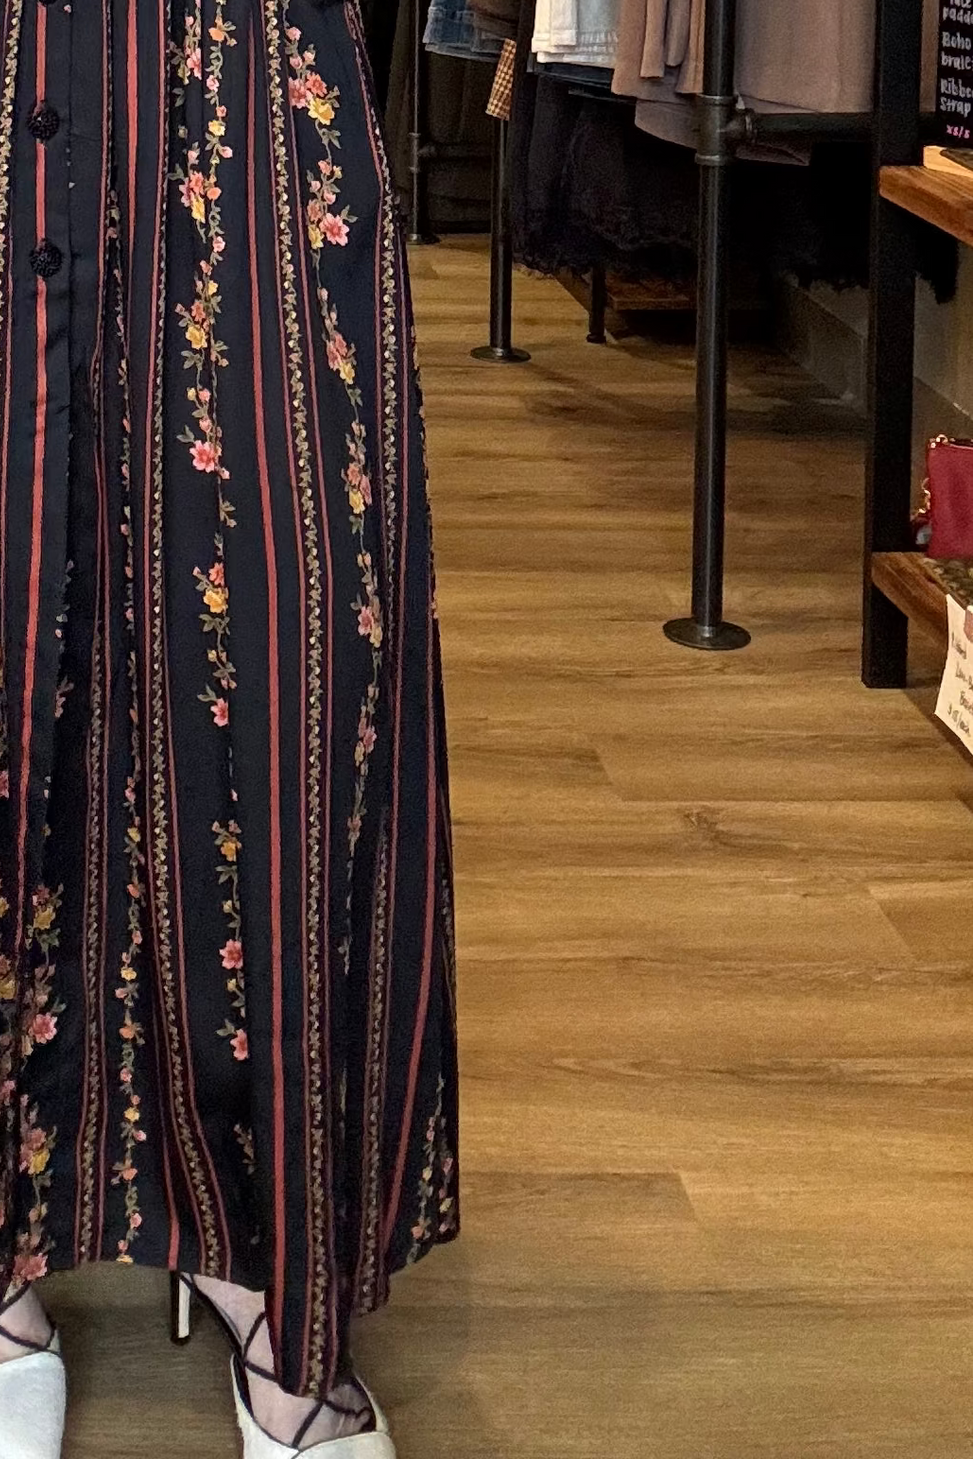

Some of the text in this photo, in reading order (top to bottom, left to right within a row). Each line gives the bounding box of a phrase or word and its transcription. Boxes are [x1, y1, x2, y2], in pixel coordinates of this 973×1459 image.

[942, 31, 972, 51] Boho
[941, 50, 973, 71] brale
[940, 77, 973, 98] Ribbe
